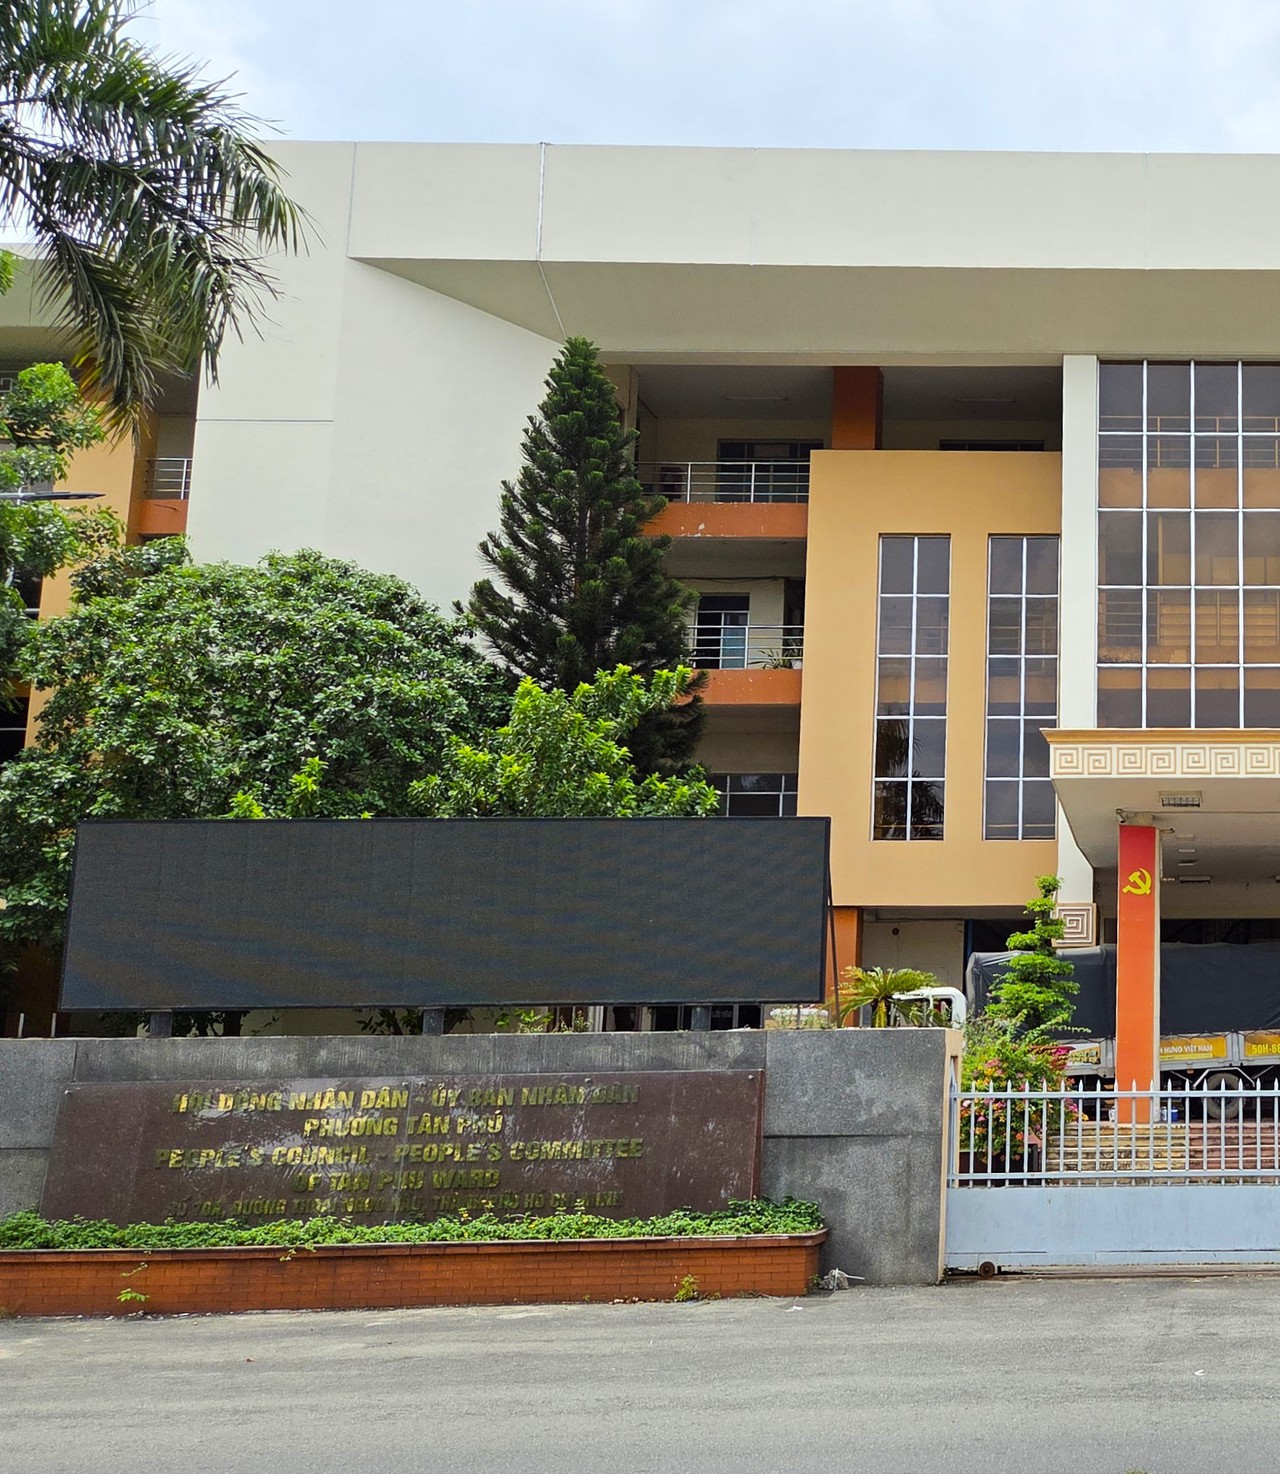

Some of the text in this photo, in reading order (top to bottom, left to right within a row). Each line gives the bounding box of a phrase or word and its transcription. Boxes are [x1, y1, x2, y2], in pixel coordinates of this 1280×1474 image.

[288, 1087, 354, 1112] NHÂN
[360, 1086, 408, 1110] DÂN
[466, 1087, 515, 1108] BAN
[520, 1083, 586, 1106] NHÂN
[407, 1112, 450, 1136] TÂN
[456, 1110, 504, 1134] PHÚ
[271, 1145, 370, 1167] COUNCIL
[509, 1138, 644, 1161] COMMITTEE
[292, 1171, 322, 1193] OF
[329, 1171, 372, 1192] TAN
[432, 1169, 500, 1189] WARD
